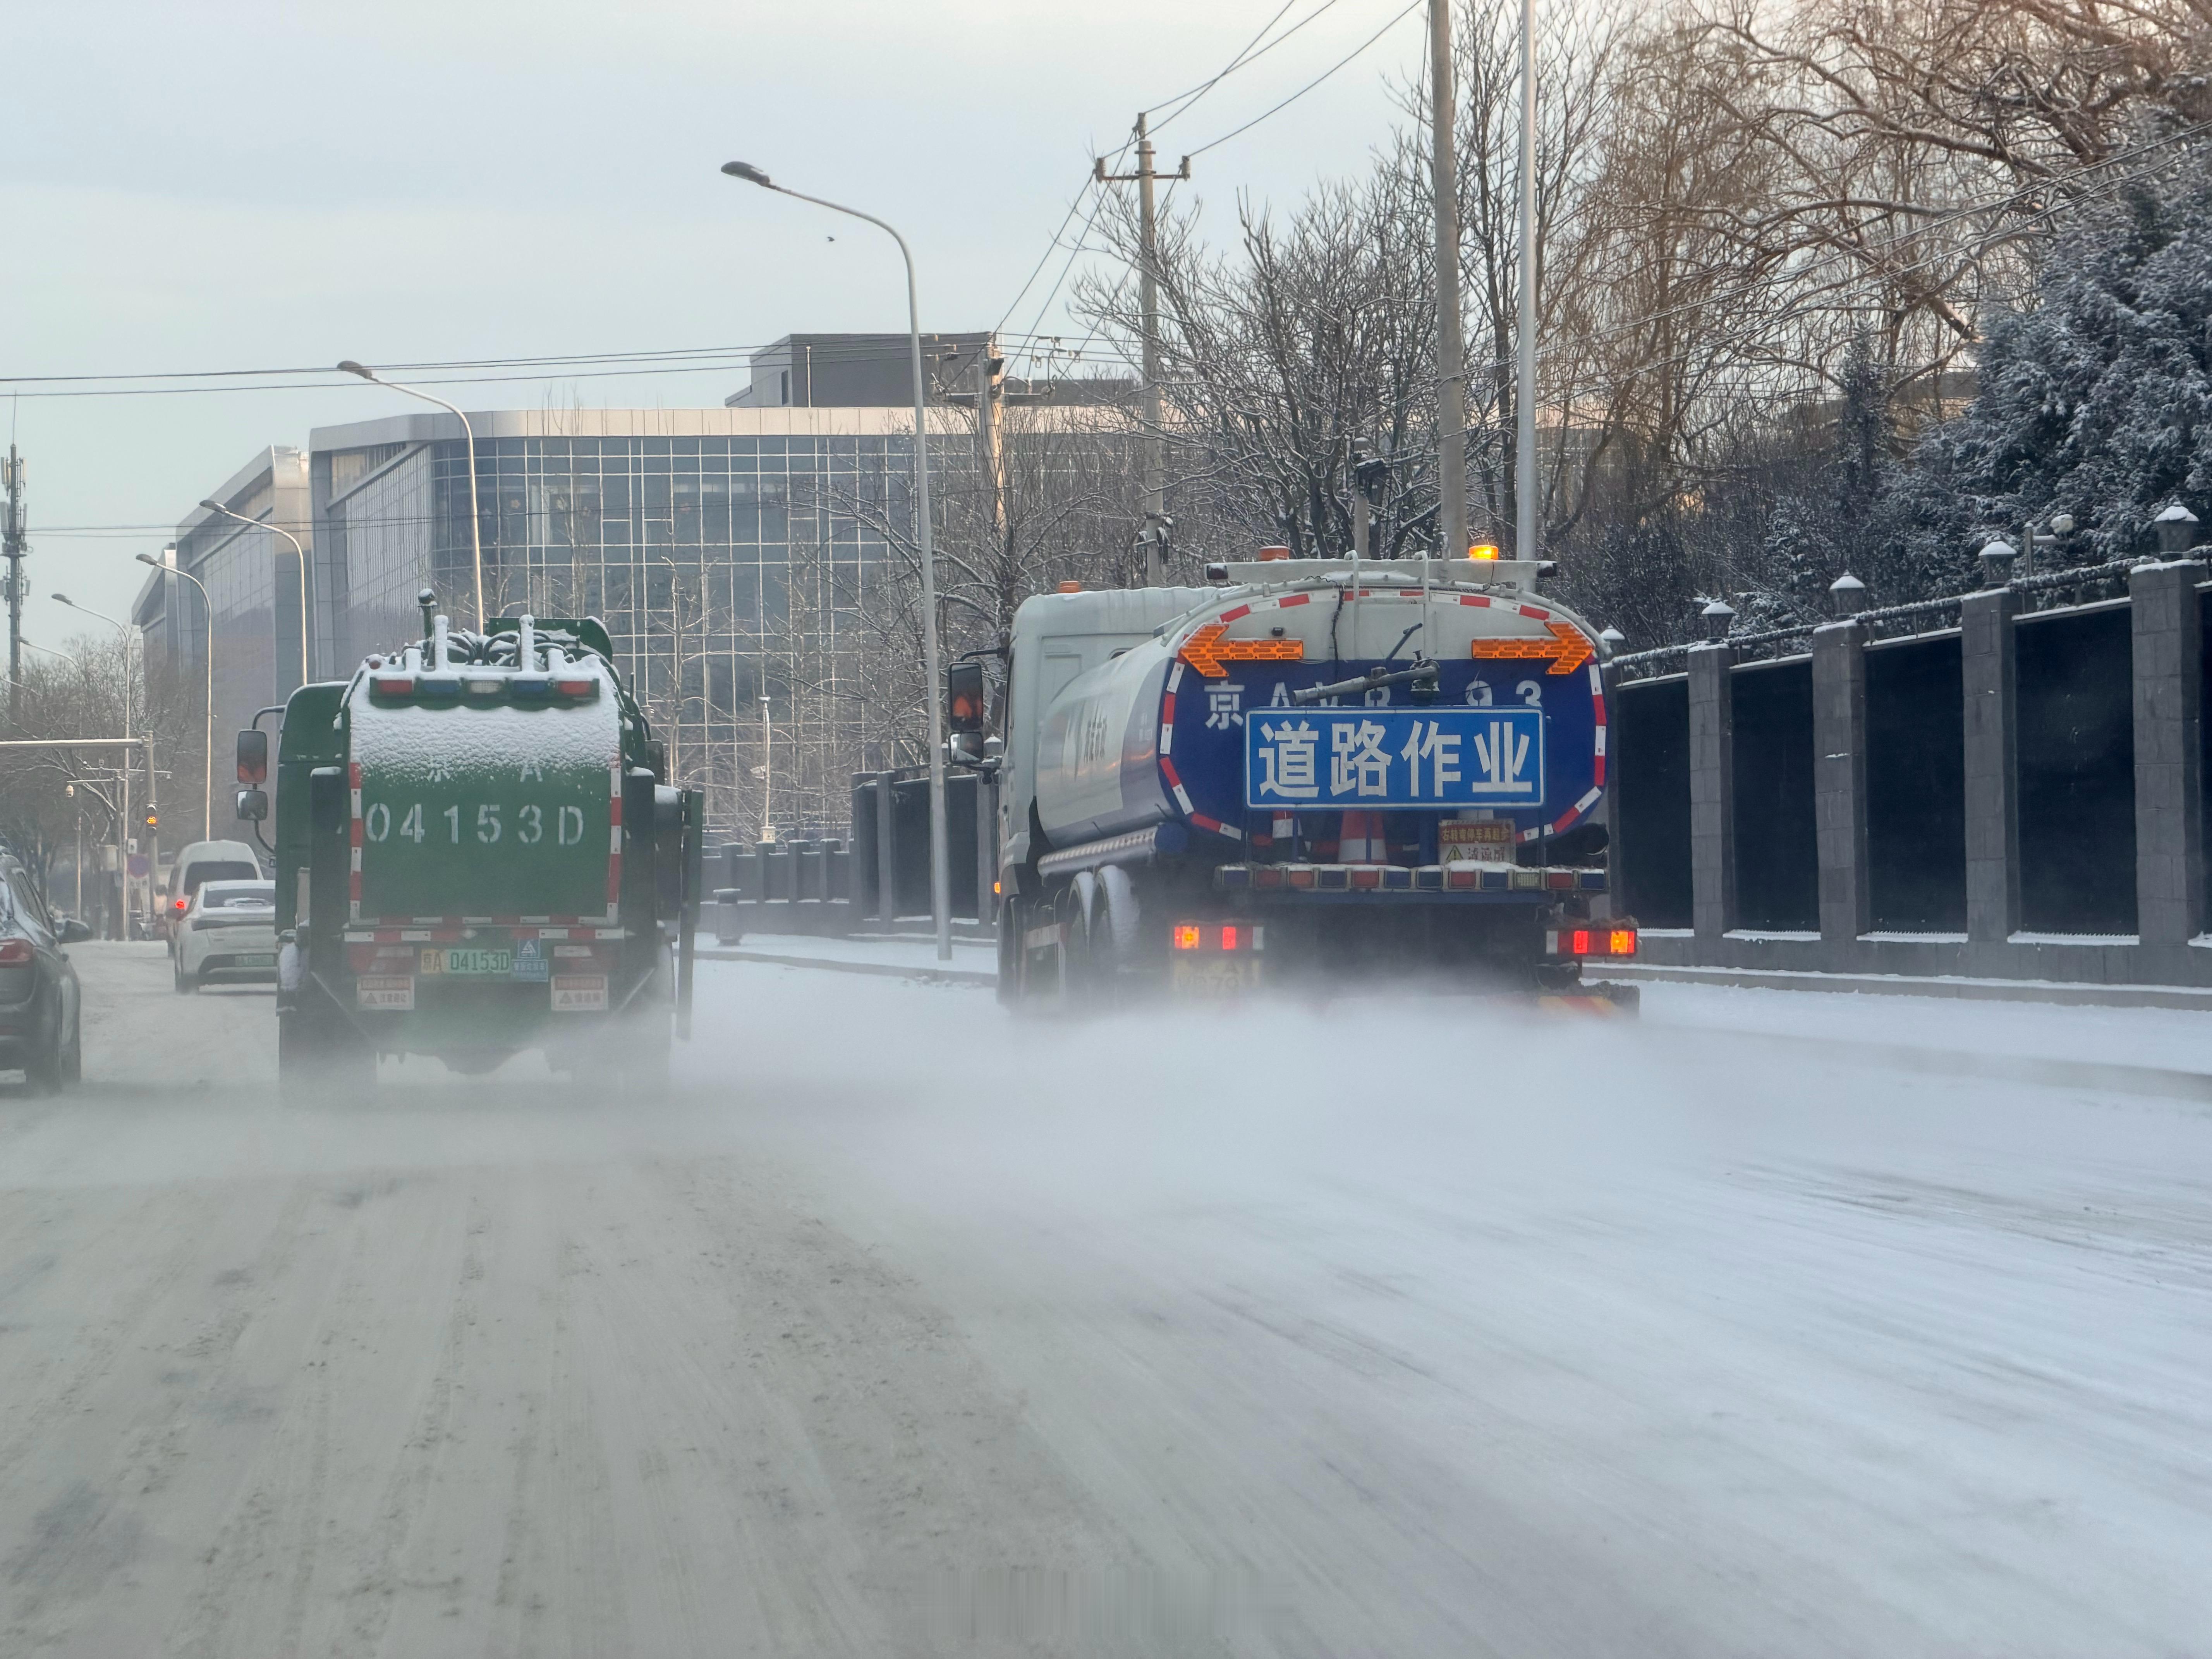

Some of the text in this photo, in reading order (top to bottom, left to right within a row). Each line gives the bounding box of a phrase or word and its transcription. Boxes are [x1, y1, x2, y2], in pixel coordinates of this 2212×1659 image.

[1204, 680, 1542, 730] 京A93
[1259, 719, 1532, 798] 道路作业
[366, 802, 583, 845] 04153D
[450, 952, 510, 971] 04153D
